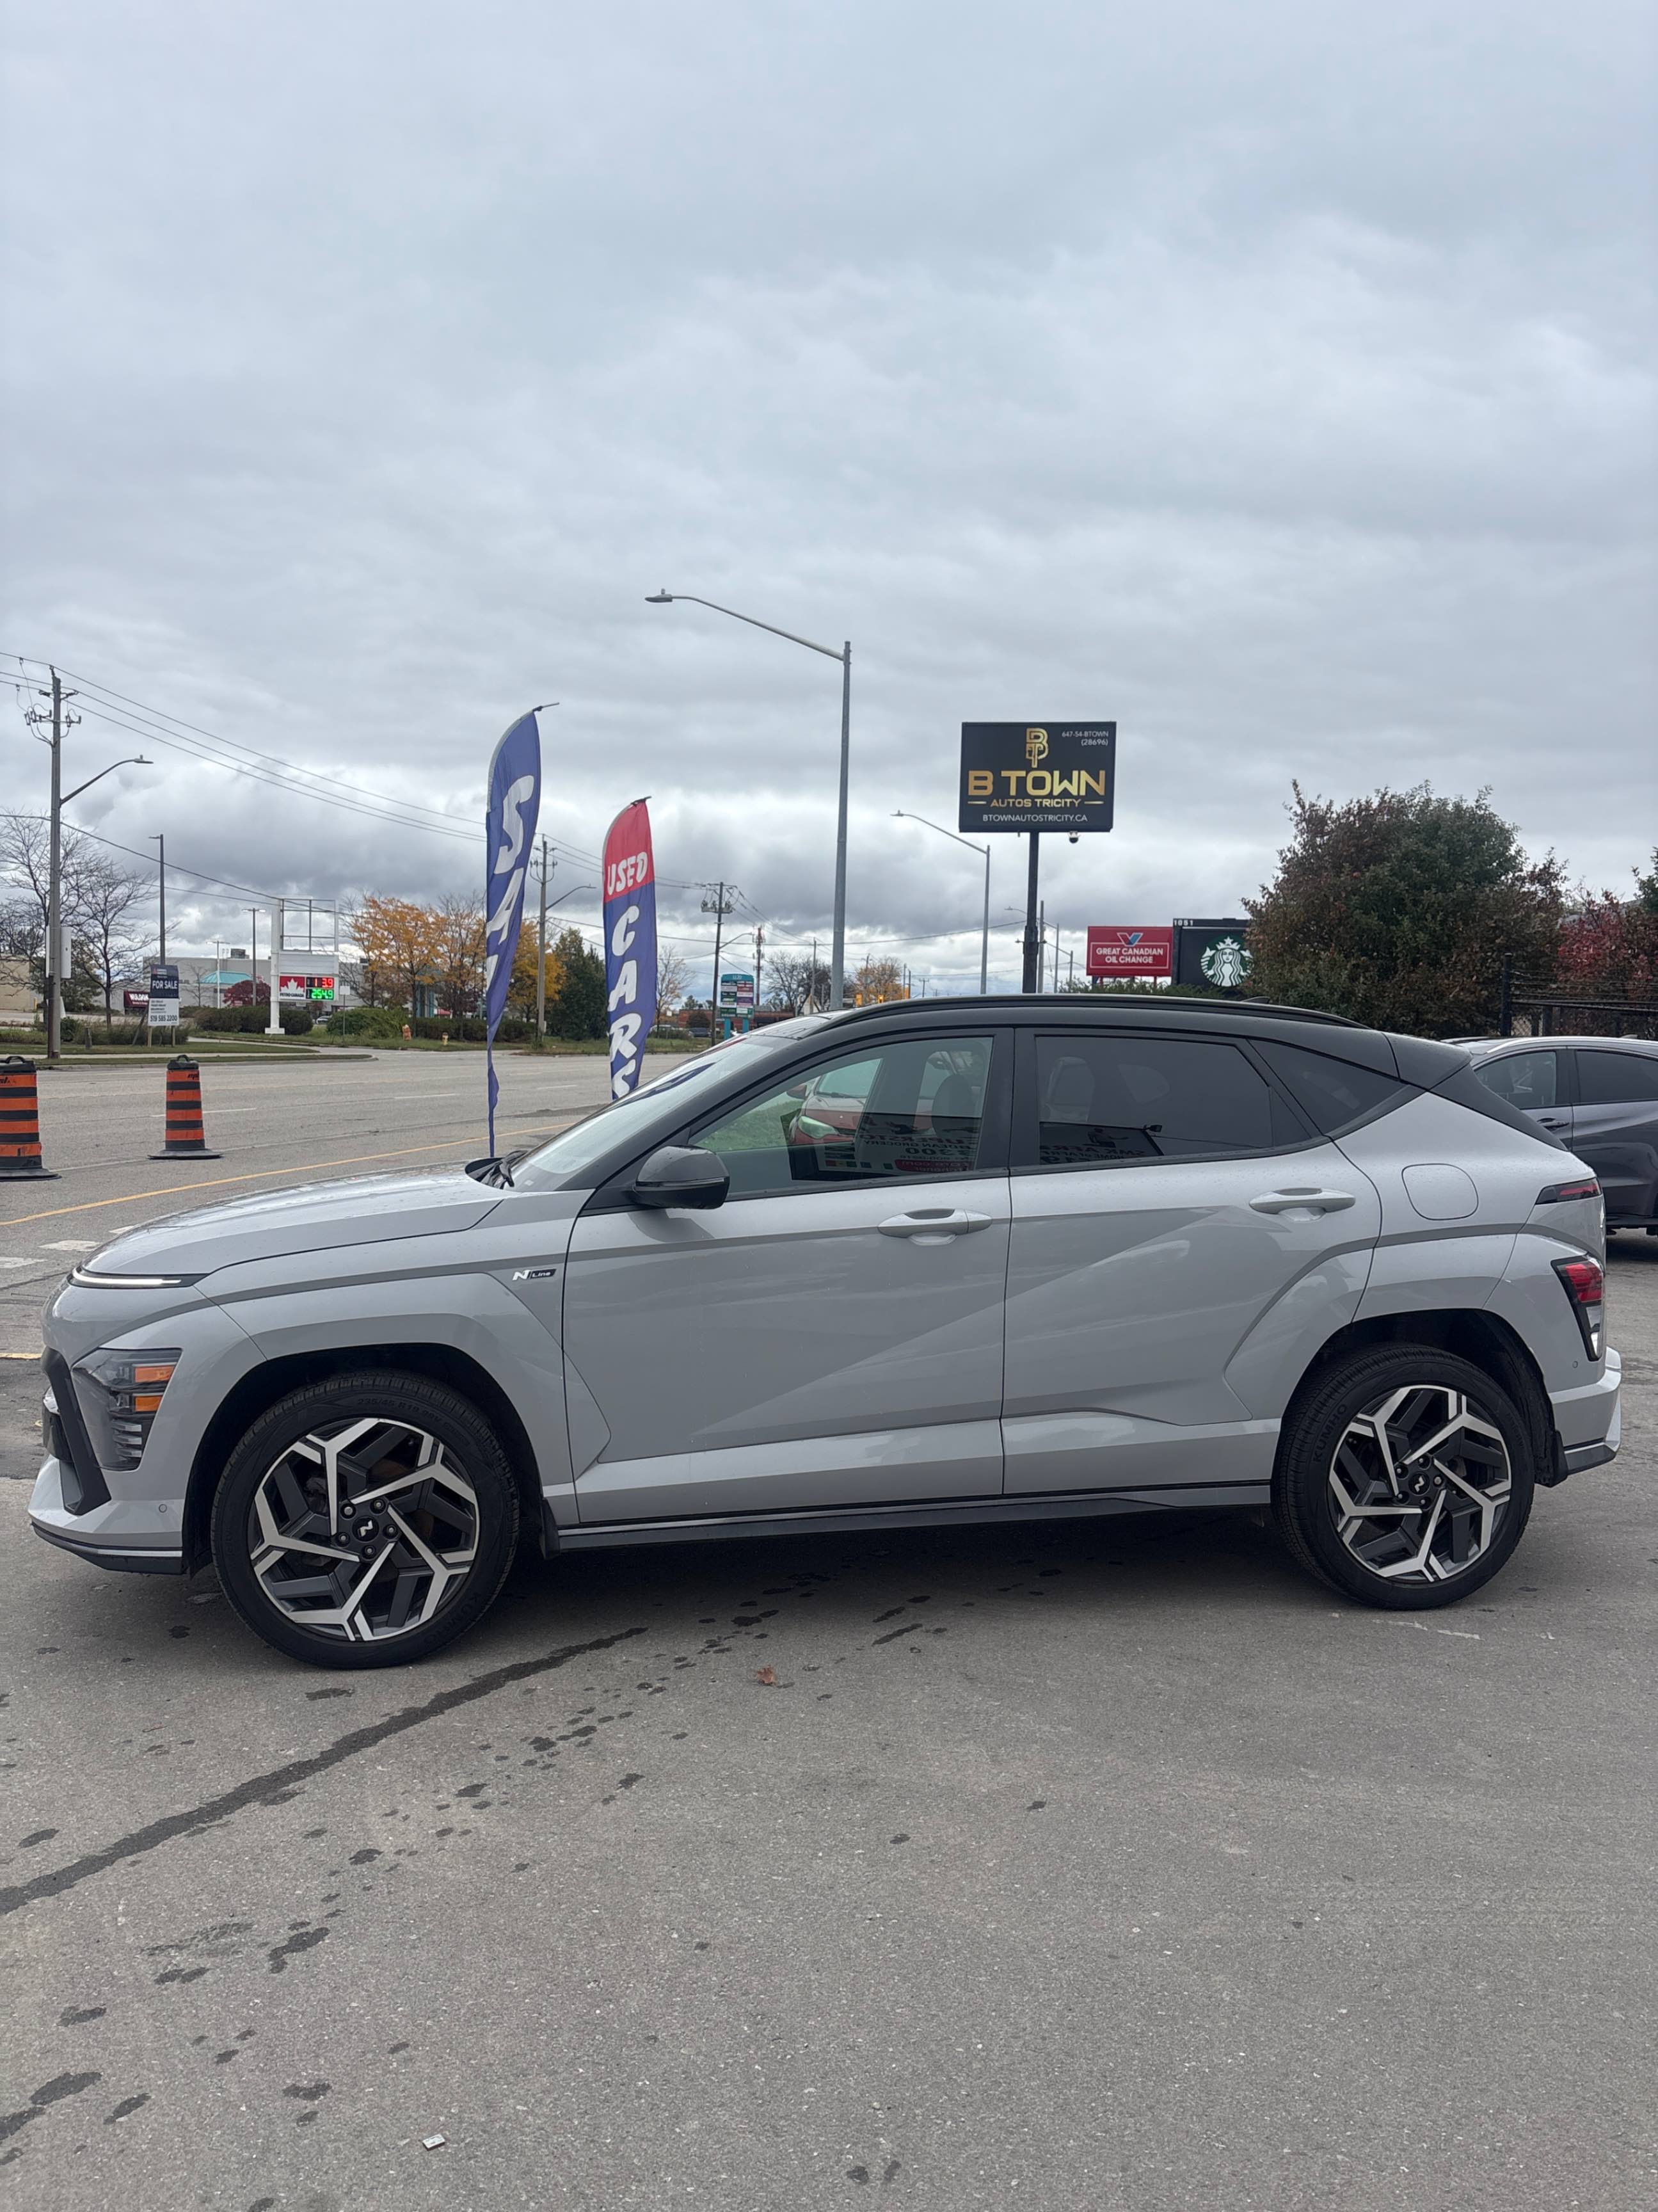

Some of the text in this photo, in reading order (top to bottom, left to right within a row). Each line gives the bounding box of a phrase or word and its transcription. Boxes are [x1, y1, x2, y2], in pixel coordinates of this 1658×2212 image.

[968, 770, 1105, 796] B TOWN
[991, 799, 1081, 808] AUTOS TRICITY
[607, 851, 648, 895] USED
[1096, 947, 1164, 956] GREAT CANADIAN
[152, 981, 178, 989] FOR SALE
[513, 1270, 530, 1280] N
